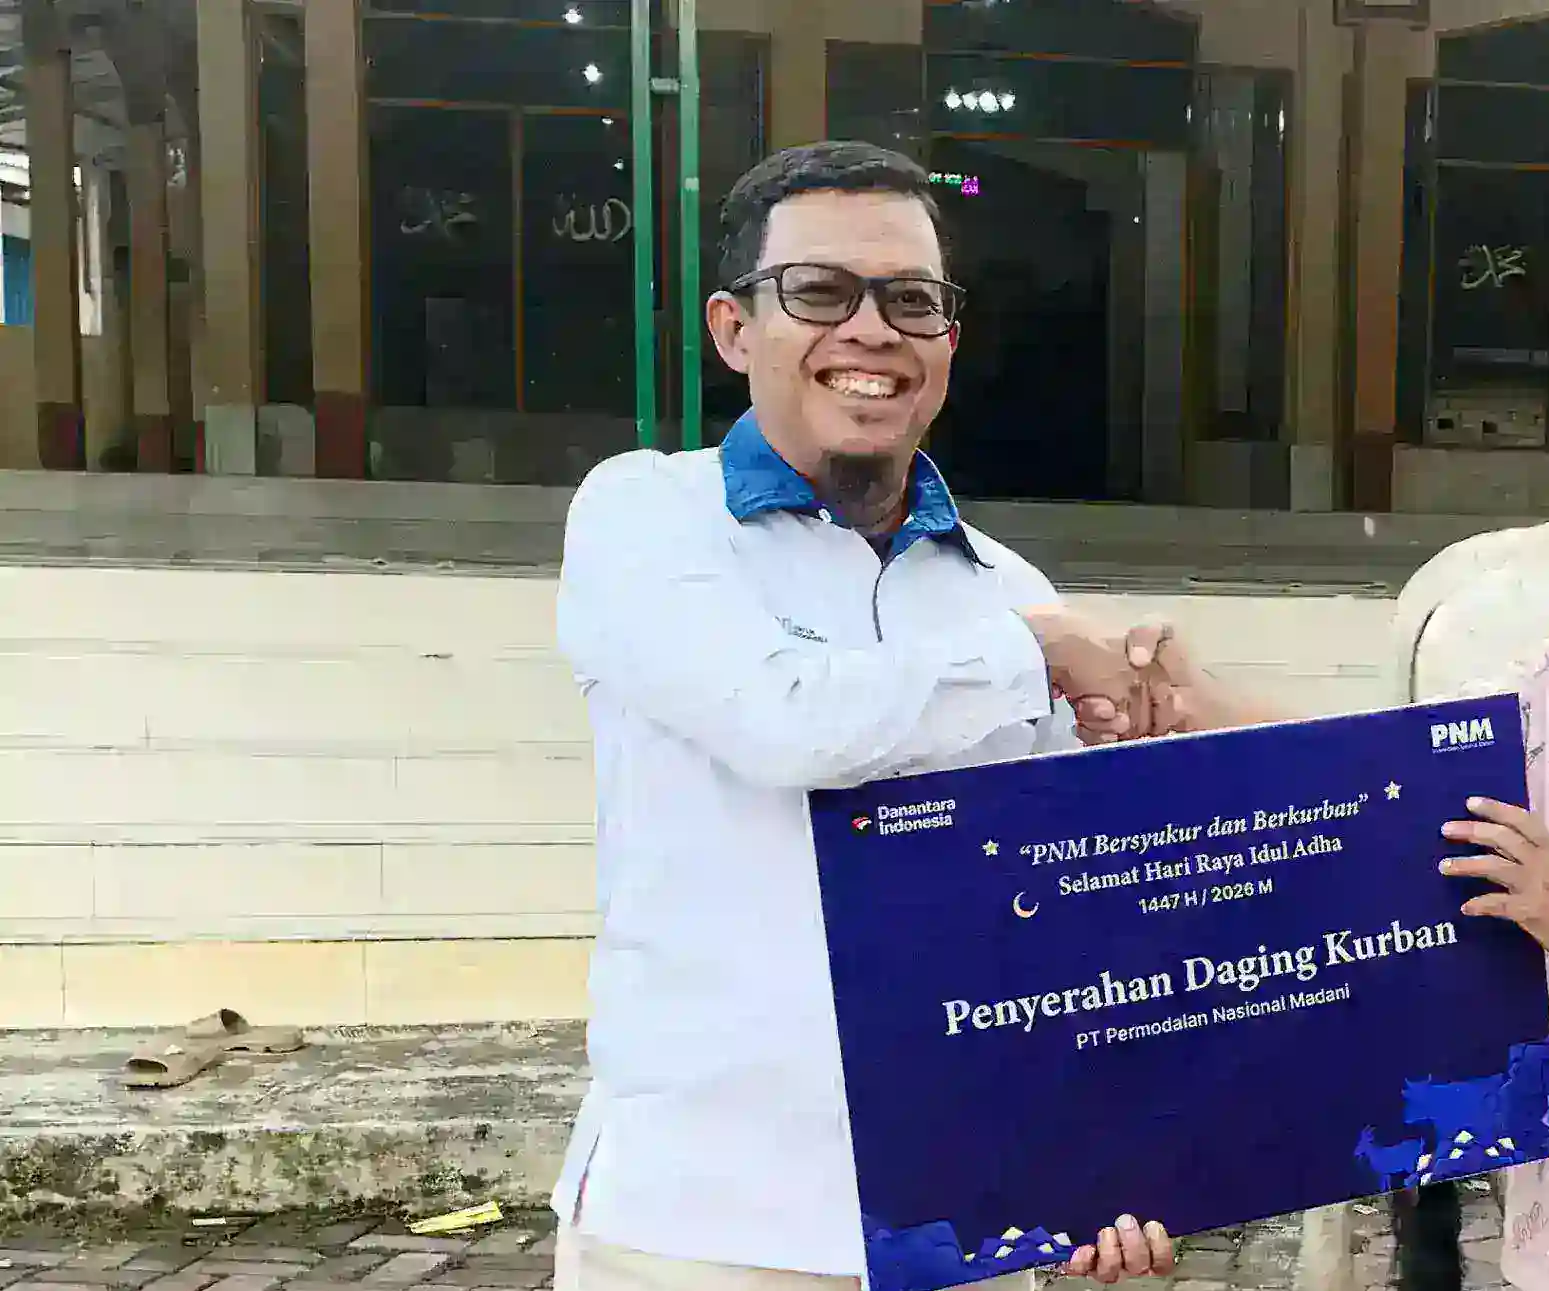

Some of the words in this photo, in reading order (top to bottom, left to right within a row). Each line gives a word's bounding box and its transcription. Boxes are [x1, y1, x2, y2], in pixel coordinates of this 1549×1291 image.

[1431, 717, 1494, 748] PNM
[877, 799, 956, 820] Danantara
[879, 812, 953, 835] Indonesia
[1093, 823, 1202, 854] Bersyukur
[1207, 816, 1247, 838] dan
[1058, 869, 1140, 896] Selamat
[1144, 857, 1191, 882] Hari
[1196, 852, 1245, 876] Raya
[1249, 840, 1288, 866] Idul
[1293, 834, 1343, 859] Adha
[1138, 891, 1180, 914] 1447
[1184, 890, 1198, 907] H
[1201, 887, 1208, 907] /
[1211, 882, 1254, 903] 2026
[1258, 878, 1273, 895] M
[942, 970, 1174, 1036] Penyerahan
[1183, 944, 1318, 992] Daging
[1322, 919, 1458, 966] Kurban
[1076, 1030, 1100, 1050] PT
[1105, 1011, 1208, 1044] Permodalan
[1212, 996, 1286, 1023] Nasional
[1290, 982, 1350, 1009] Madani
